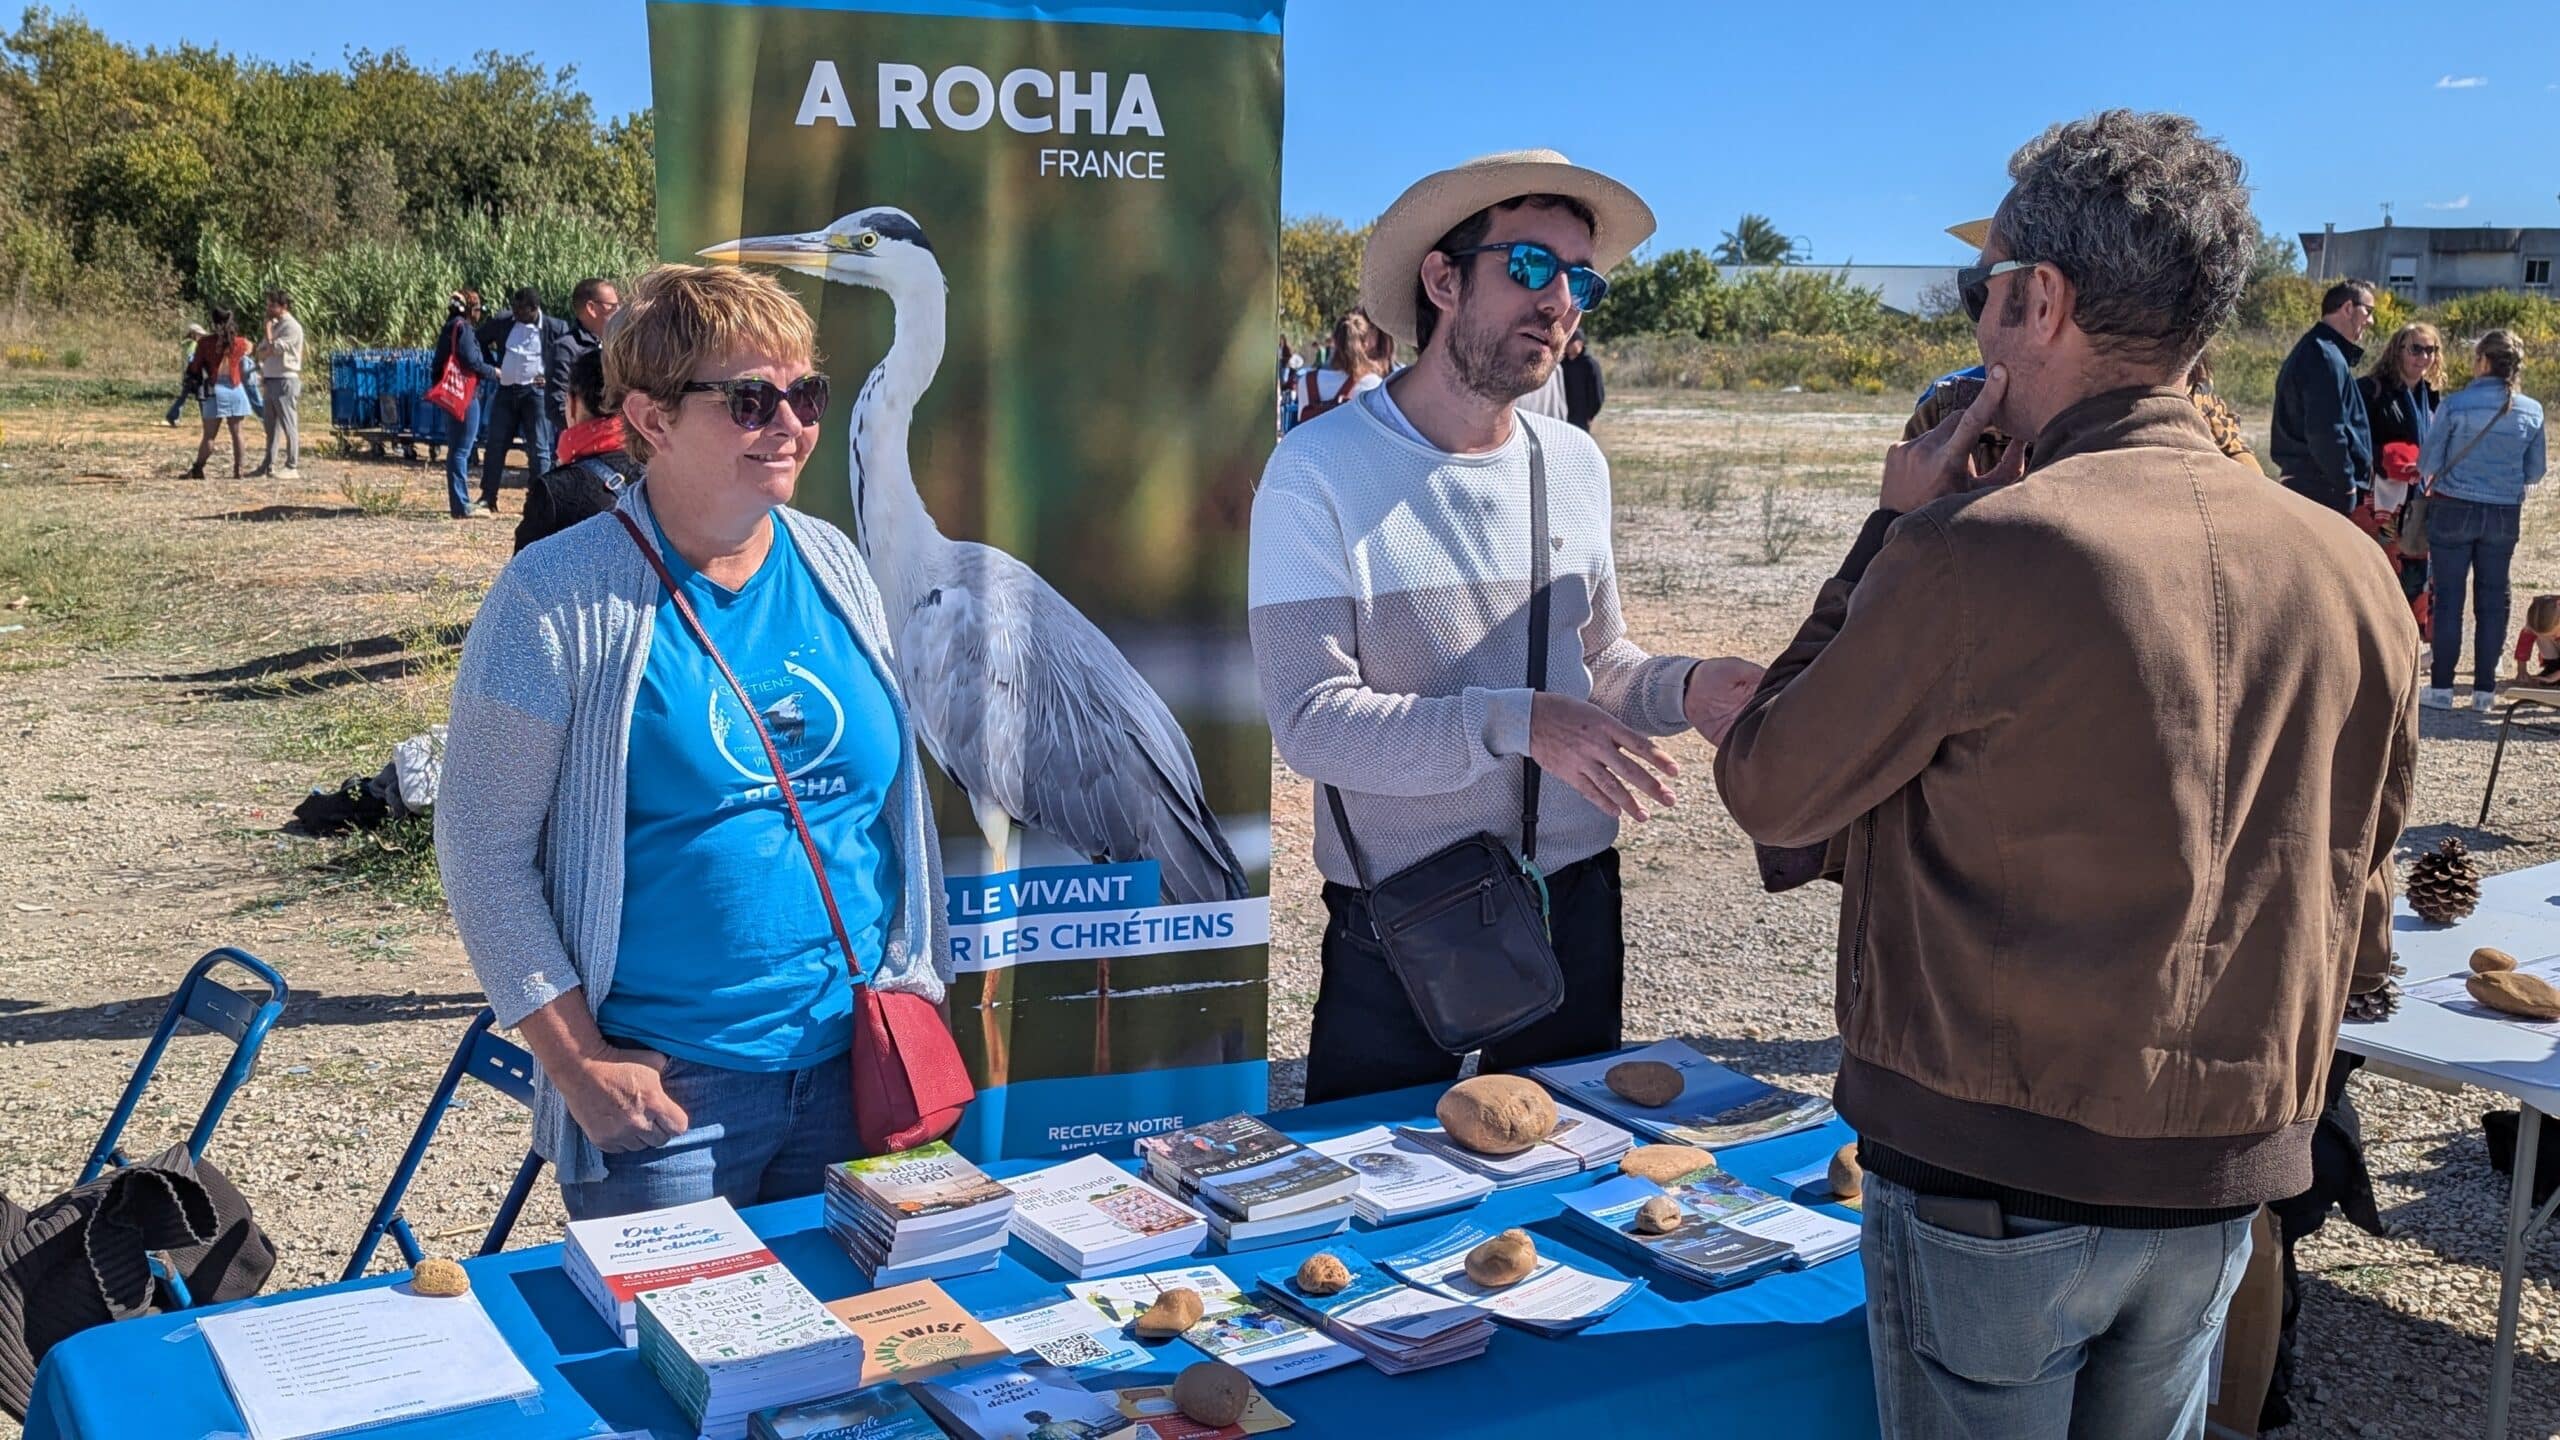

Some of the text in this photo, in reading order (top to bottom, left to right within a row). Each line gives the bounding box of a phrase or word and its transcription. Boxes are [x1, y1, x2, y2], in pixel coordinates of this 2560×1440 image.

[795, 60, 1166, 138] A ROCHA
[1040, 148, 1166, 181] FRANCE
[718, 675, 793, 697] CHÉTIENS
[962, 888, 1001, 917] LE
[1008, 875, 1133, 908] VIVANT
[984, 926, 1039, 960] LES
[1051, 911, 1234, 950] CHRÉTIENS
[1048, 1115, 1184, 1140] RECEVEZ NOTRE
[1194, 1163, 1222, 1176] Foi
[1070, 1174, 1119, 1194] monde
[695, 1290, 762, 1310] Disciple
[711, 1302, 765, 1318] Christ
[848, 1312, 874, 1322] DAVE
[972, 1377, 1029, 1398] Un Dieu
